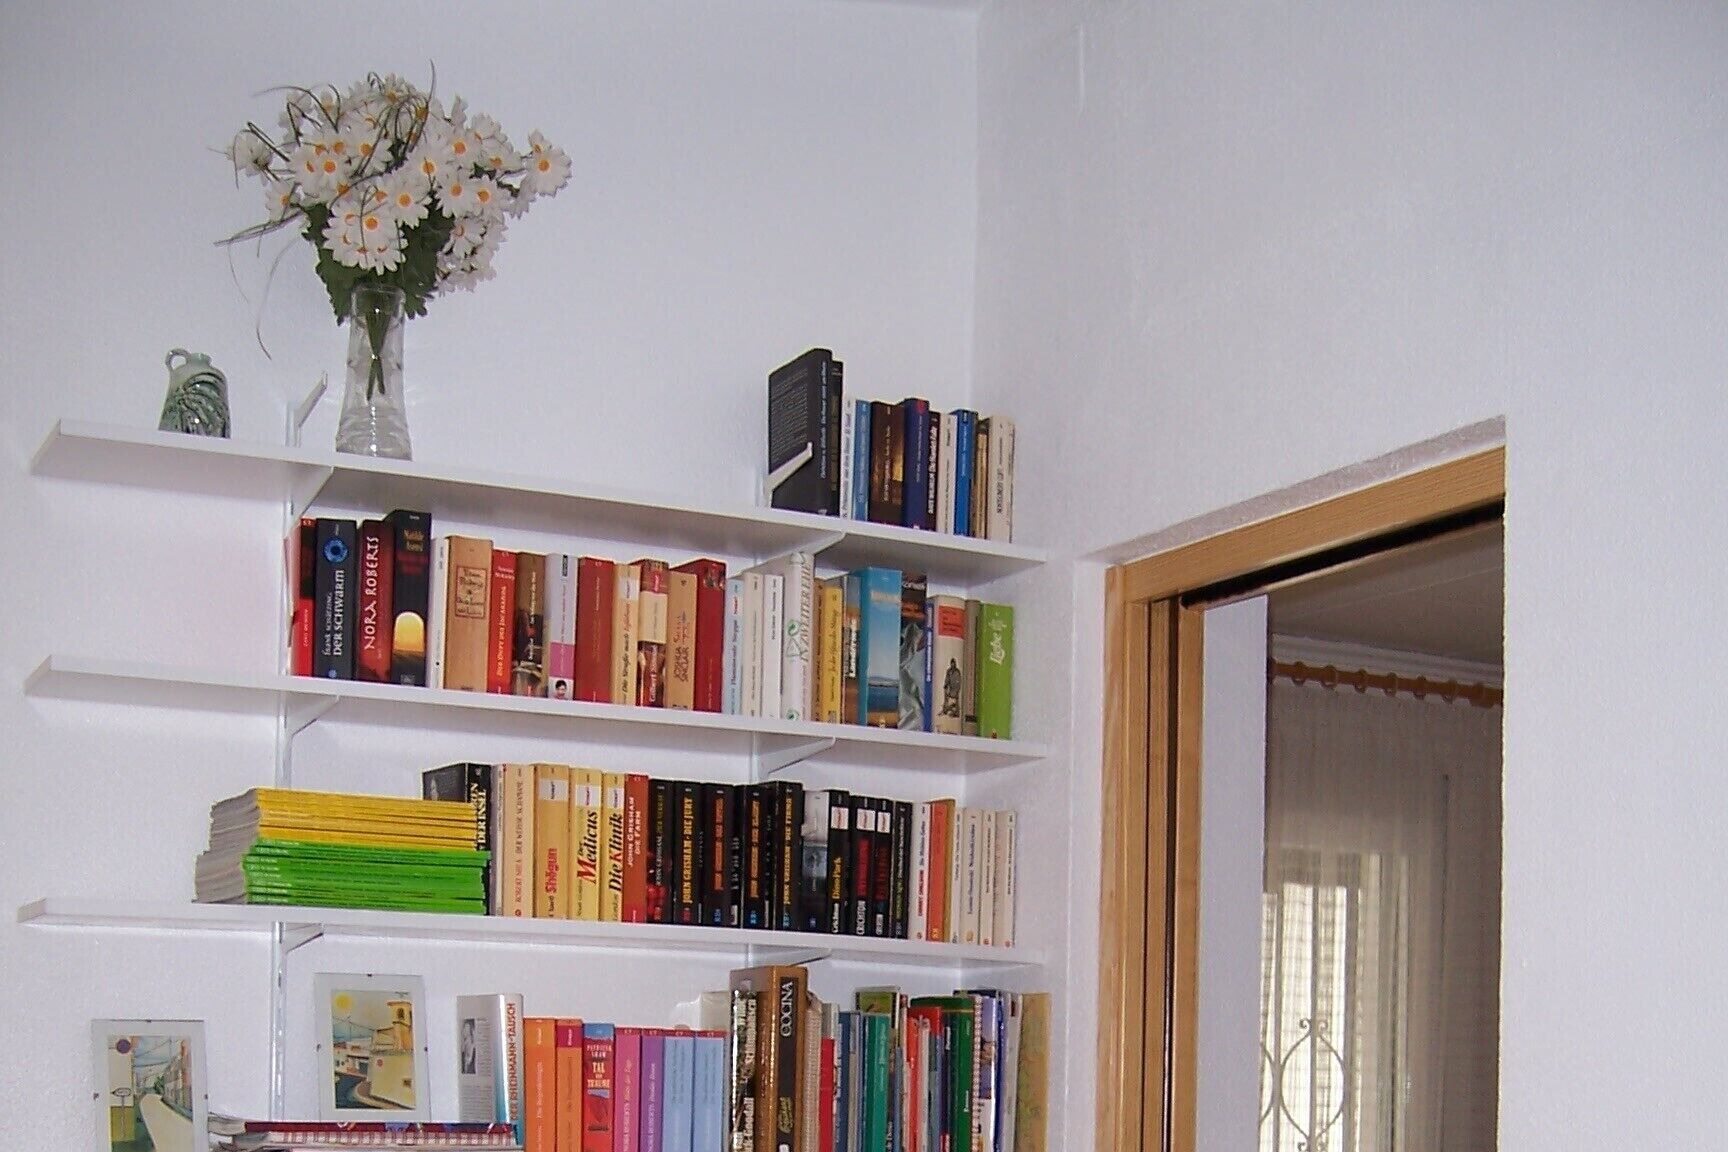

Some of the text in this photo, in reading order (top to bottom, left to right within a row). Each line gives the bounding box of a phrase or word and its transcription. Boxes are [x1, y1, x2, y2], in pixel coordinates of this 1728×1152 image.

[363, 535, 379, 650] NORA ROBERTS
[477, 787, 488, 821] INSEL
[627, 796, 635, 842] GRISHAM
[634, 810, 642, 838] FARM
[575, 810, 598, 885] Medicus
[575, 841, 583, 857] Der
[607, 812, 624, 863] Klinik
[681, 796, 693, 904] JOHN GRISHAM DIE JURY
[607, 863, 623, 893] Die
[780, 980, 794, 1037] COCINA
